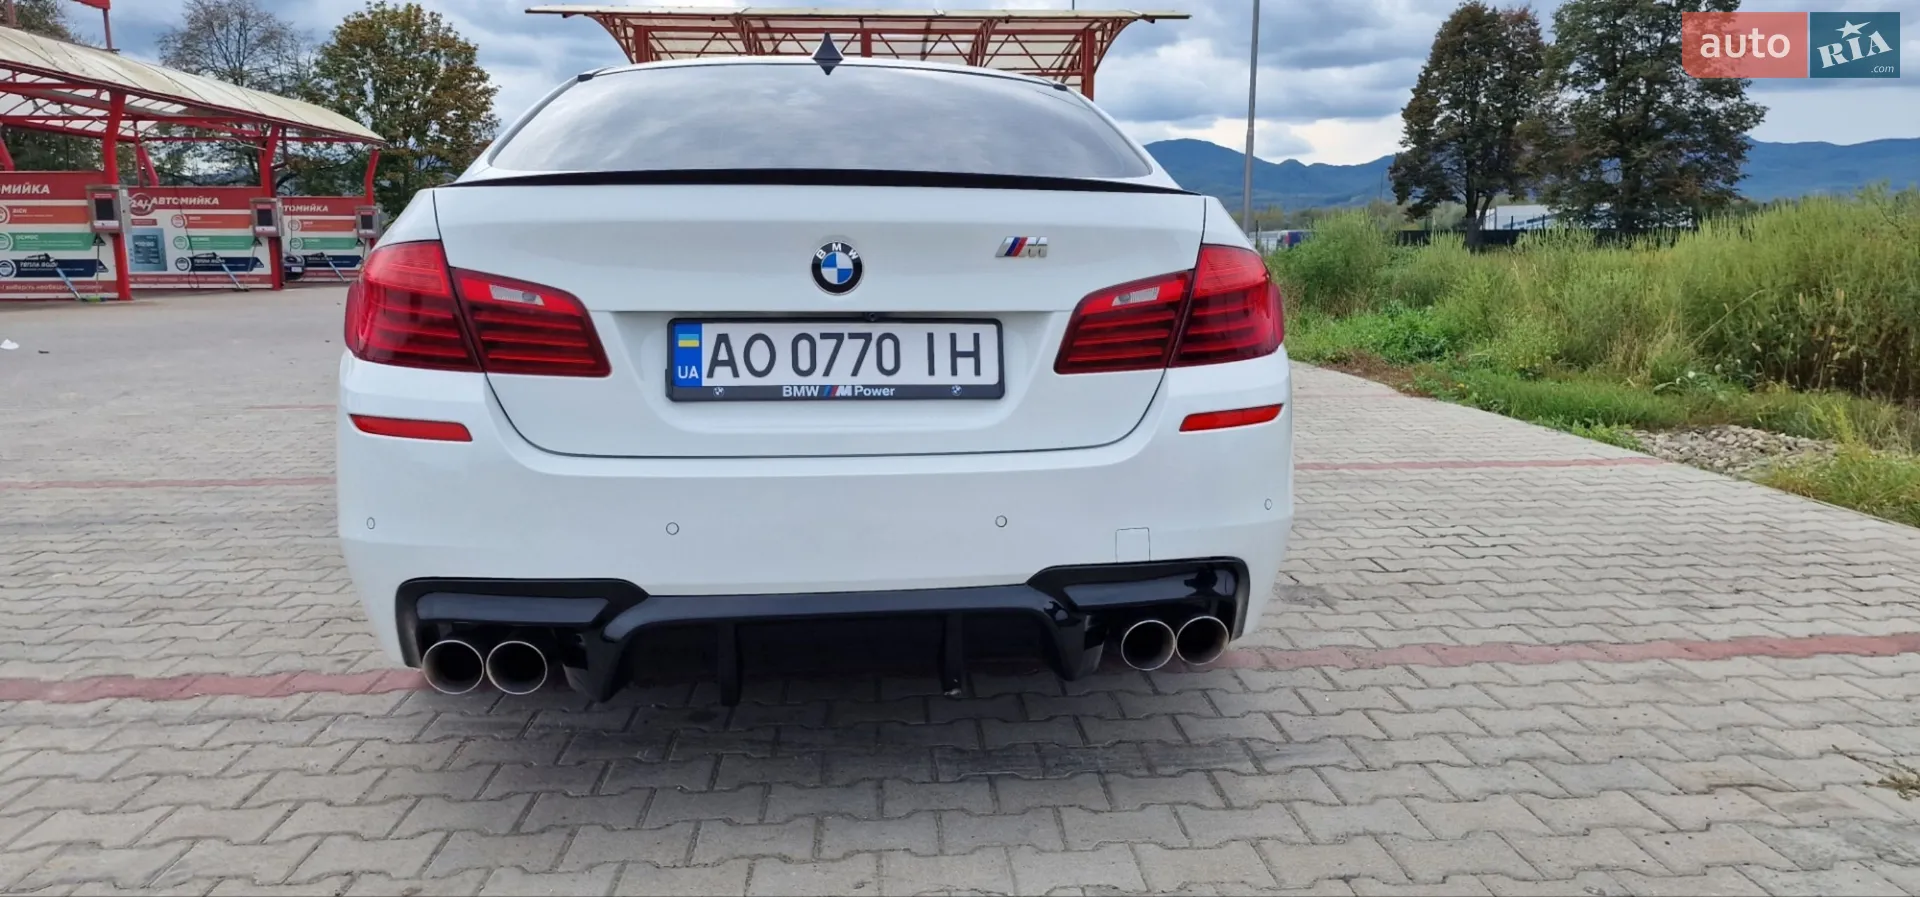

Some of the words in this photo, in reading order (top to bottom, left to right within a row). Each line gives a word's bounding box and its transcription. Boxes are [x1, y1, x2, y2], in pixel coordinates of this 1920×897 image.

[0, 181, 50, 194] МИЙКА
[151, 195, 219, 205] АВТОМИЙКА
[815, 242, 859, 261] BMW
[706, 332, 777, 379] AO
[790, 332, 901, 377] 0770
[927, 332, 982, 377] IH
[678, 365, 699, 380] UA
[782, 386, 820, 398] BMW
[854, 386, 896, 398] Power
